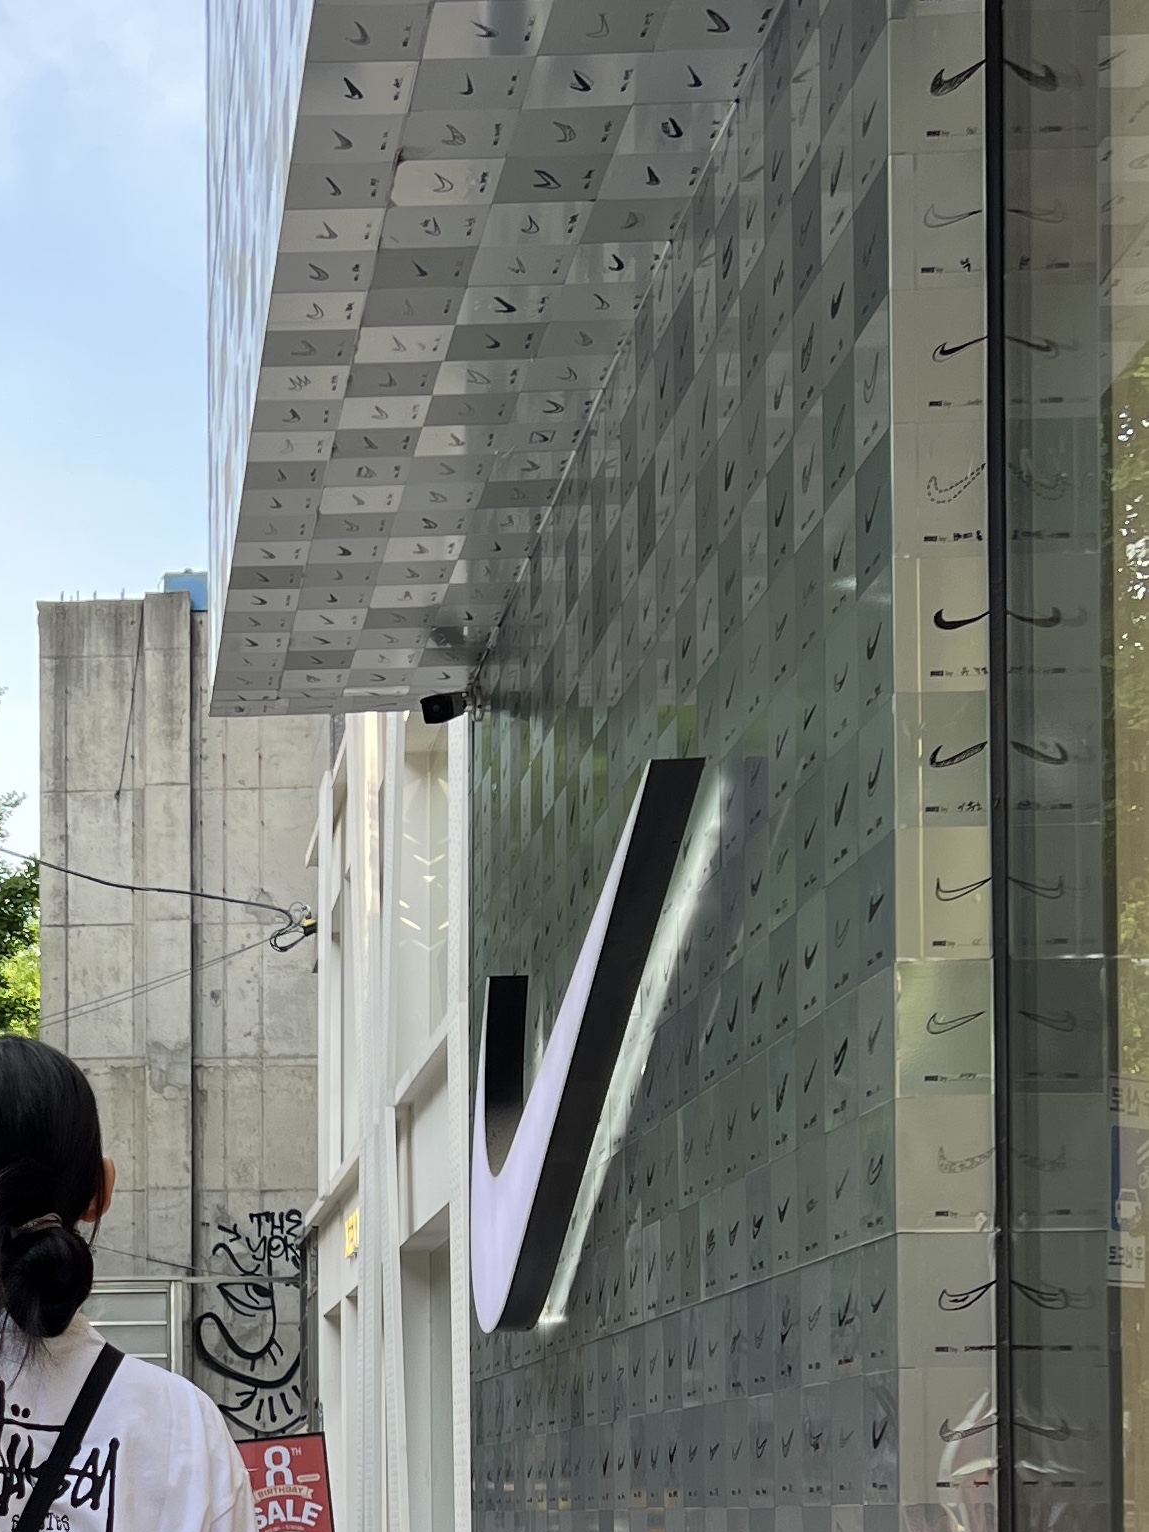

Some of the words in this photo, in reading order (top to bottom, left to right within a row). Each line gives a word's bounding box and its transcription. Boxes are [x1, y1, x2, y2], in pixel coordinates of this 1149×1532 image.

[249, 1209, 302, 1238] THE
[258, 1486, 304, 1499] BIRTHDAY
[255, 1499, 323, 1531] SALE
